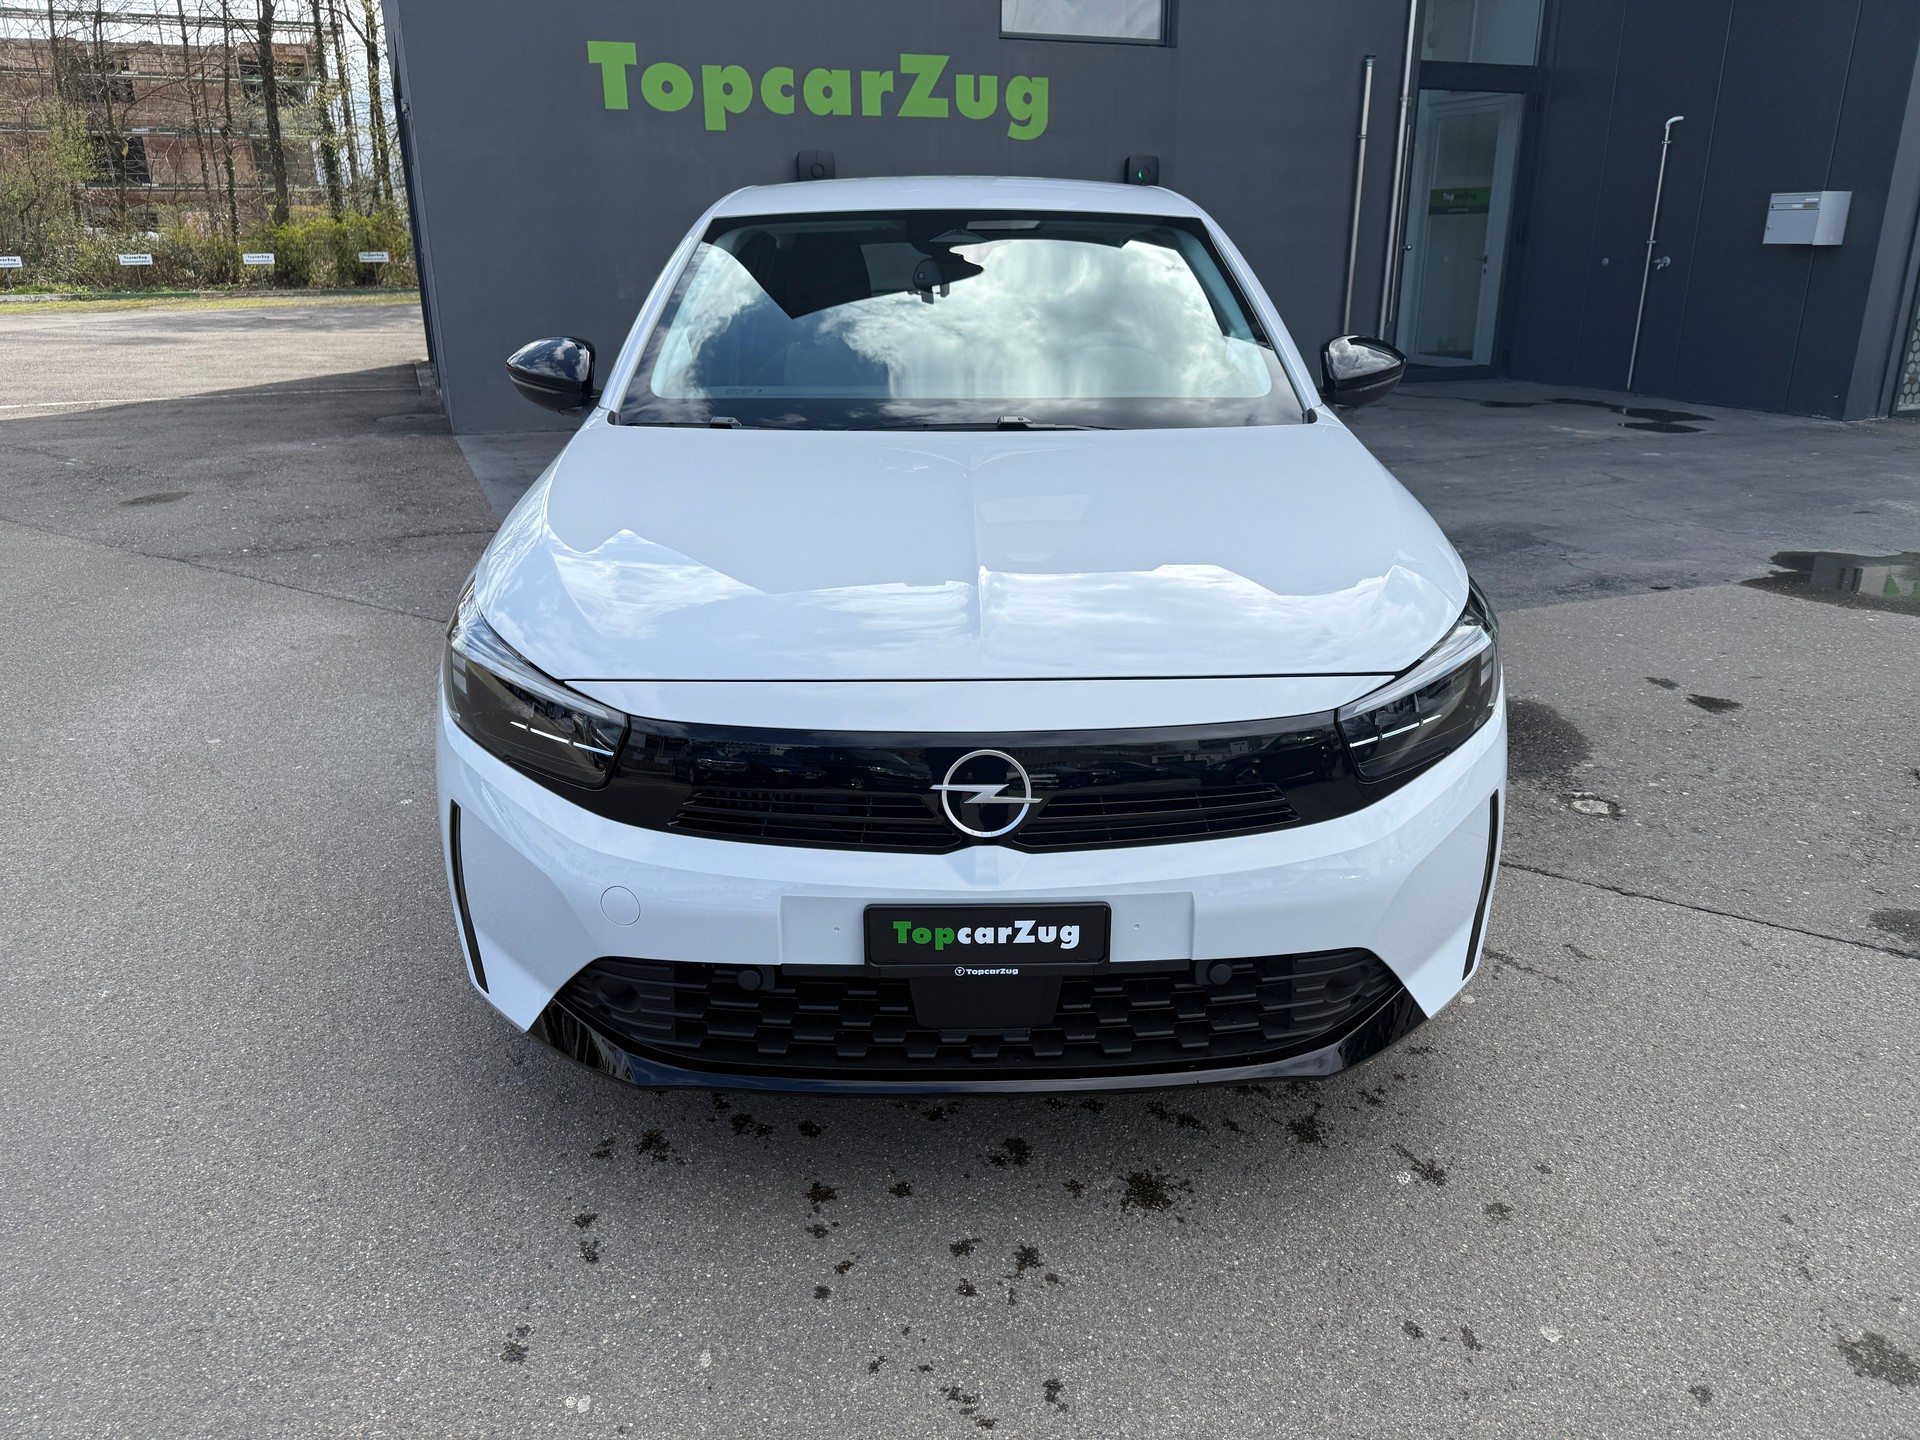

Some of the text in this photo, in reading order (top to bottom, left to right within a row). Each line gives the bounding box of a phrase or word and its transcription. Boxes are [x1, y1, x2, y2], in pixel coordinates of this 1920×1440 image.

[587, 40, 1049, 140] TopcarZug
[893, 920, 1080, 950] TopcarZug
[966, 967, 1019, 976] TopcarZug
